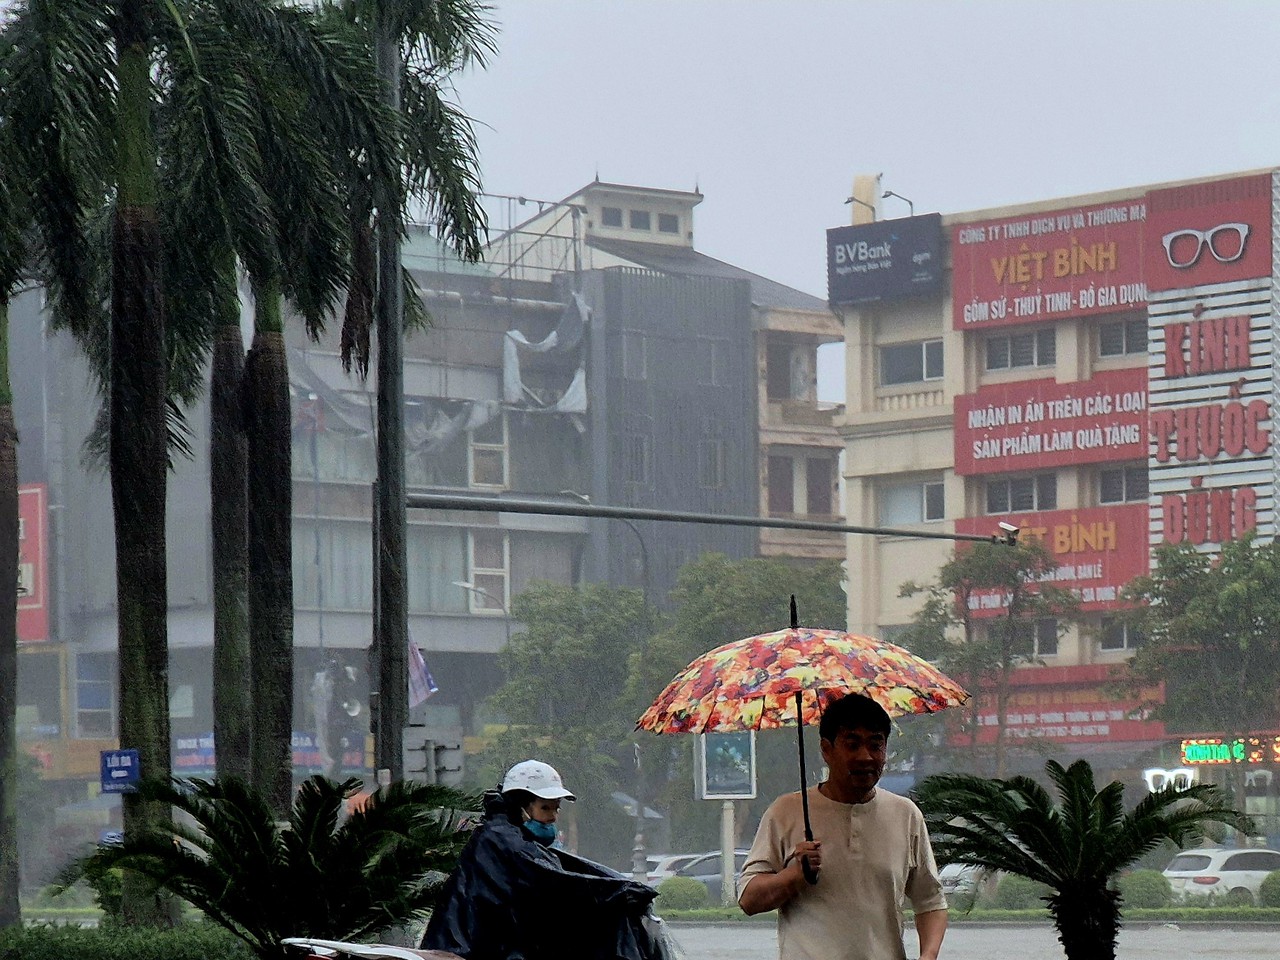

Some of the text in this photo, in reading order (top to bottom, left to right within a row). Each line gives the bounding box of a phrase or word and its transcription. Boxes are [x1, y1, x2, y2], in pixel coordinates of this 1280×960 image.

[988, 224, 1000, 241] TY
[1004, 220, 1030, 239] TNHH
[834, 241, 891, 264] BVBank
[990, 236, 1119, 292] VIỆT BÌNH
[1045, 291, 1072, 313] TINH
[1097, 285, 1117, 307] GIA
[1164, 303, 1251, 378] KÍNH
[968, 404, 1005, 430] NHẬN
[1007, 404, 1022, 425] IN
[1046, 395, 1082, 420] TRÊN
[1085, 391, 1112, 416] CÁC
[1115, 390, 1146, 415] LOẠI
[1150, 377, 1270, 463] THUỐC
[1043, 428, 1073, 452] LÀM
[1076, 422, 1103, 449] QUÀ
[1054, 515, 1118, 554] BÌNH
